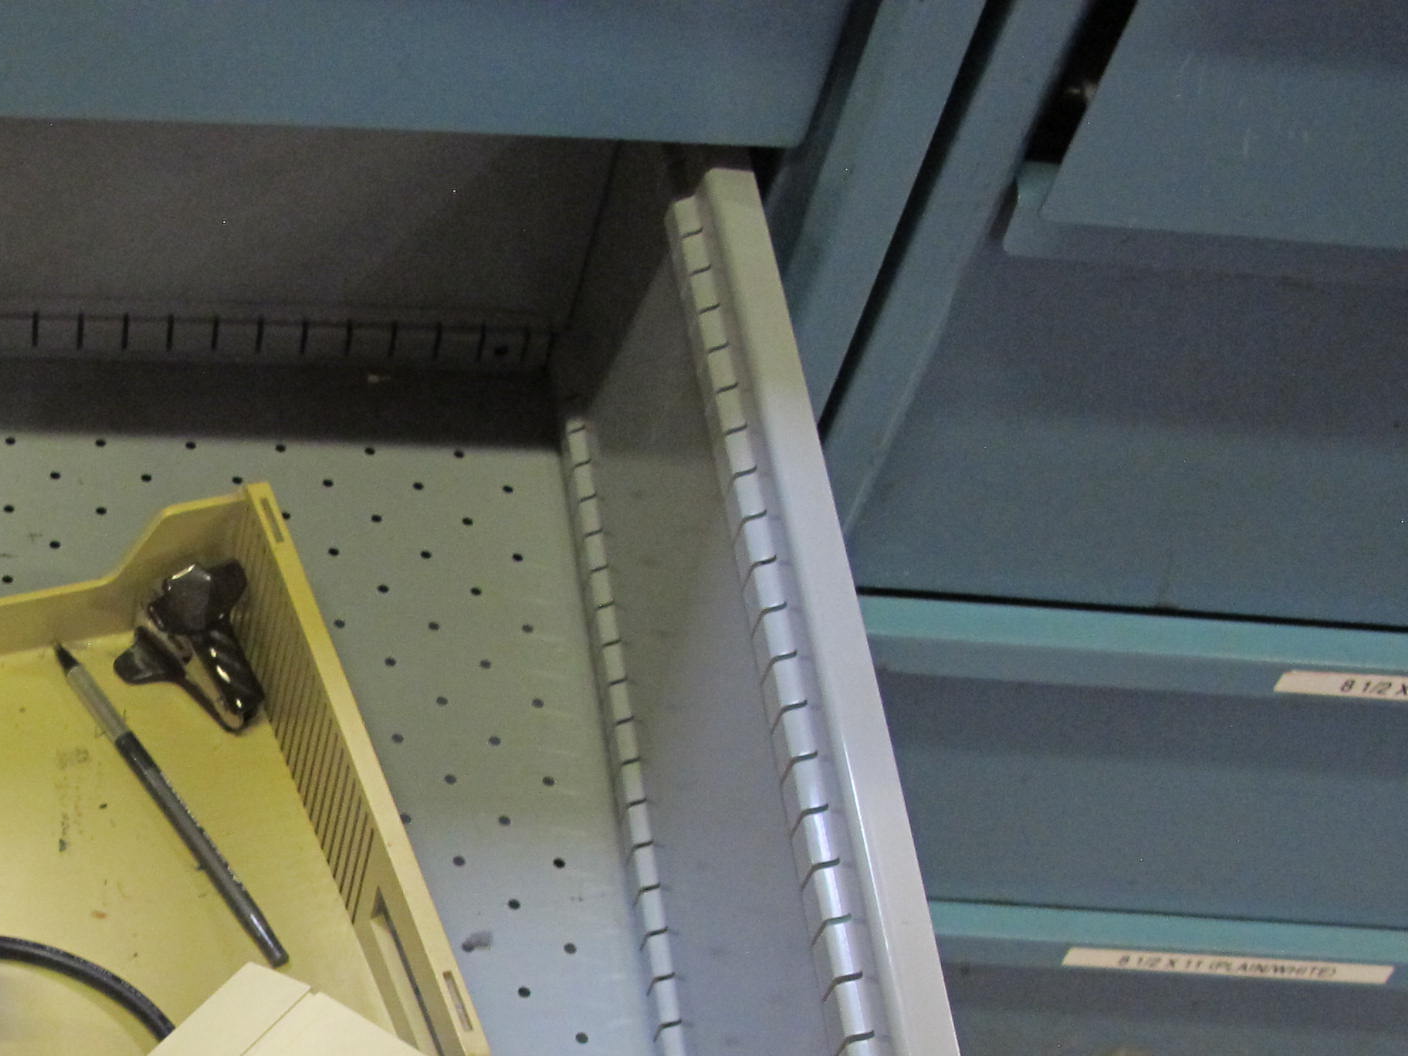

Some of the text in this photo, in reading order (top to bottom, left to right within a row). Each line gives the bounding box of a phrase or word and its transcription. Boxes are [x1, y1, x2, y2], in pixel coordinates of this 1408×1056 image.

[1340, 679, 1356, 693] 8
[1362, 680, 1393, 695] 1/2
[1118, 955, 1130, 967] 8
[1166, 958, 1179, 969] X
[1184, 959, 1204, 970] 11
